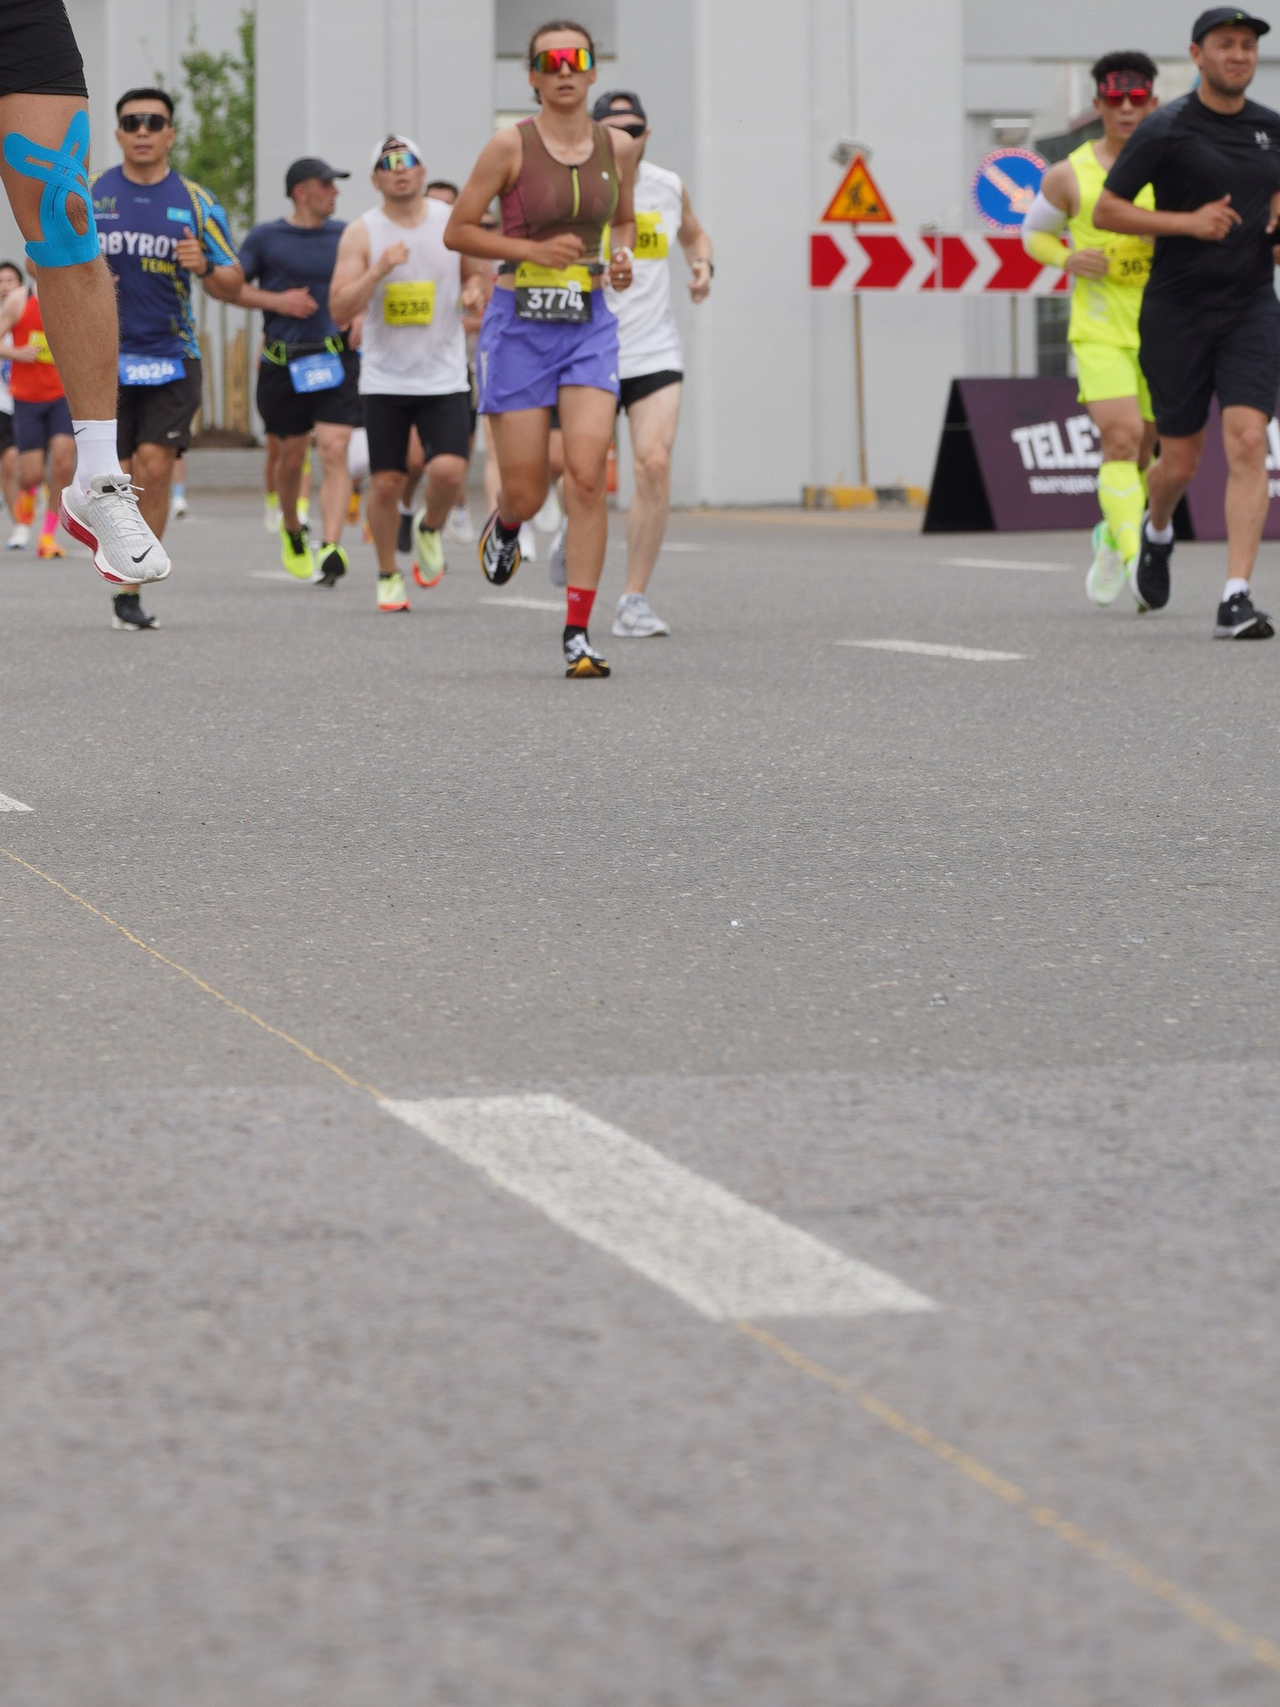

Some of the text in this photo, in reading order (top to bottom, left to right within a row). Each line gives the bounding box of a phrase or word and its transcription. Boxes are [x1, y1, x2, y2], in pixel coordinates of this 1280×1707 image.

[637, 231, 659, 249] 91
[527, 287, 585, 312] 3774
[1010, 413, 1103, 471] TELE
